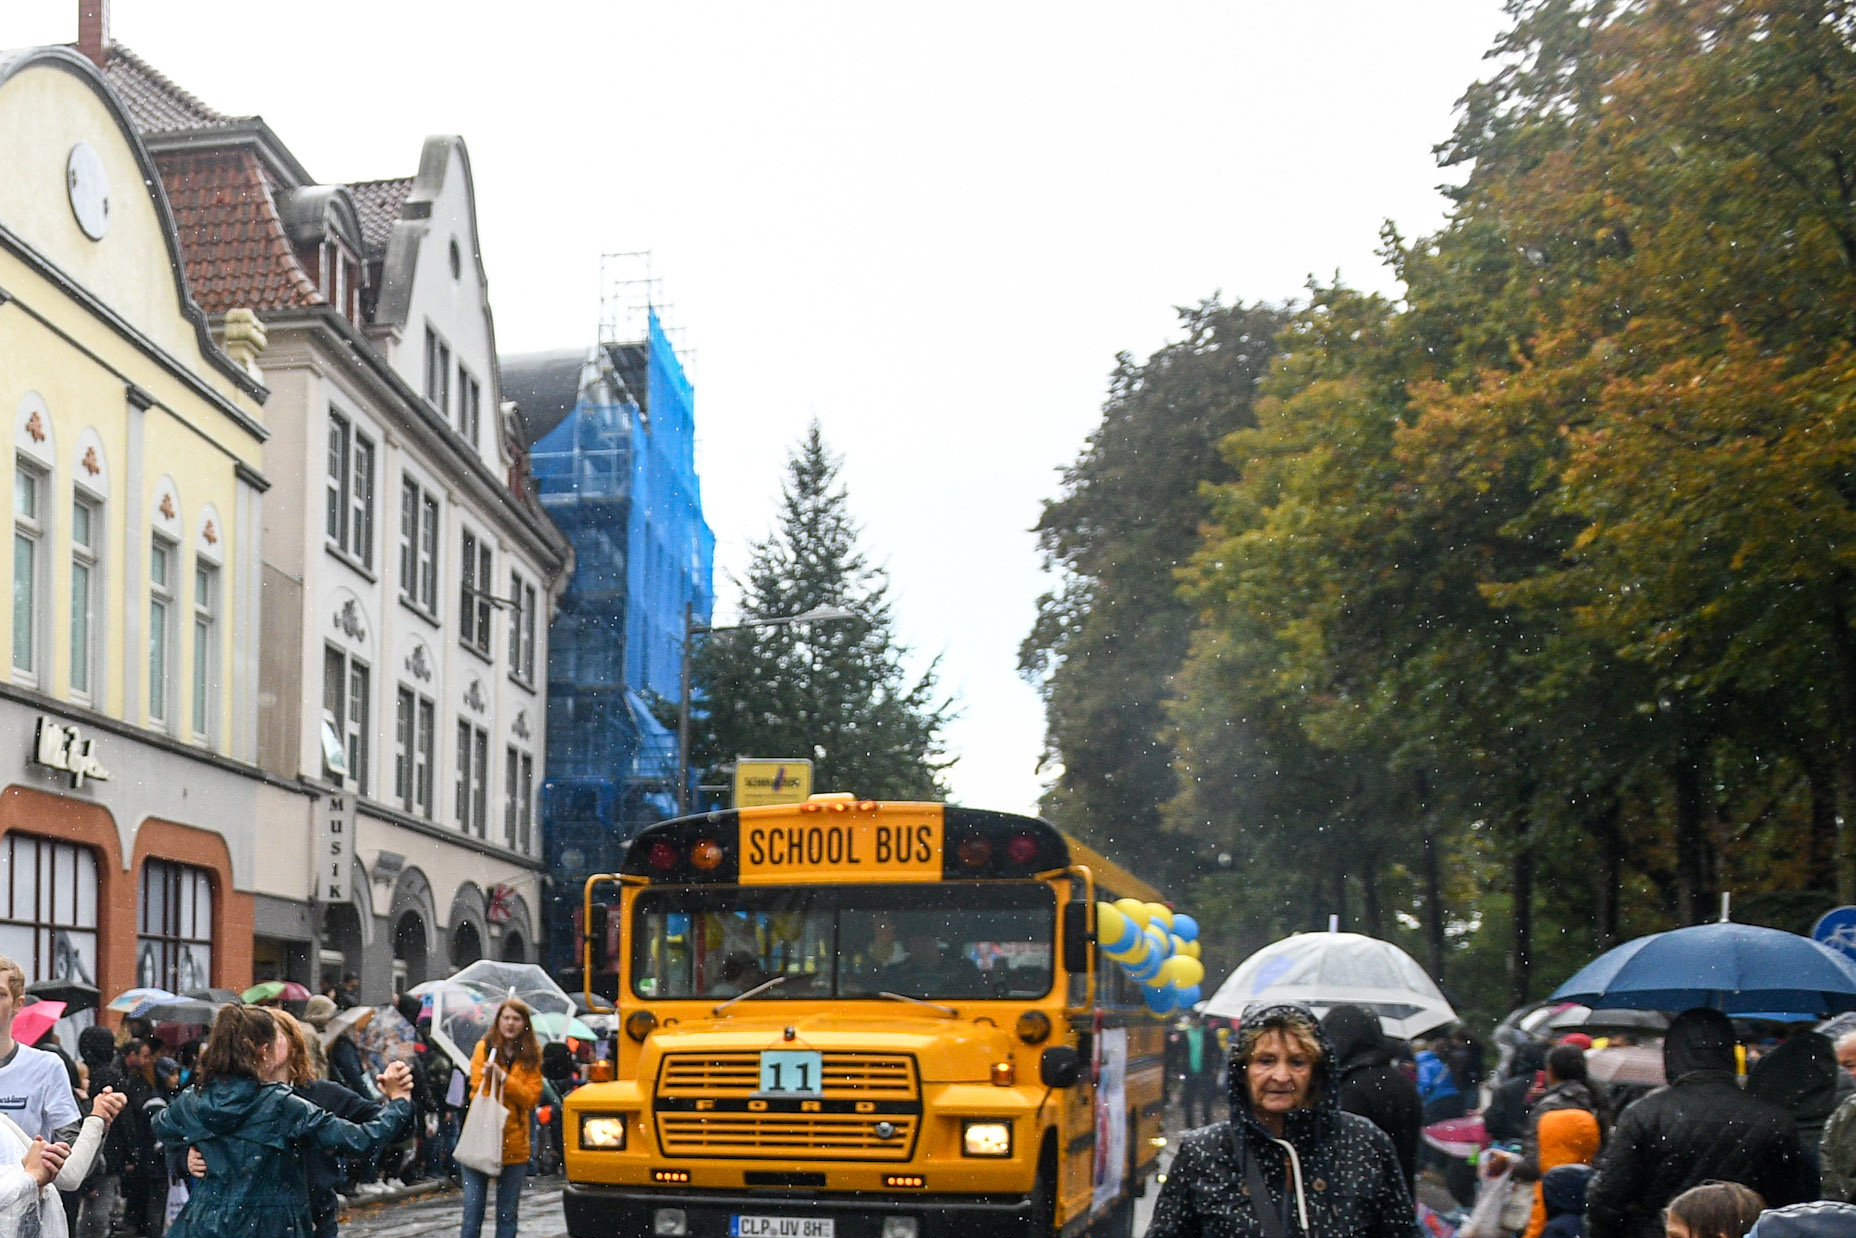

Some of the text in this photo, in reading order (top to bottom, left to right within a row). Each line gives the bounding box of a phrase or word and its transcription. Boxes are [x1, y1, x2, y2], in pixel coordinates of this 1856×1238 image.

[328, 797, 344, 899] MUSIK
[749, 825, 932, 865] SCHOOL BUS
[768, 1061, 813, 1091] 11
[695, 1099, 876, 1113] FORD
[741, 1218, 770, 1235] CLP
[780, 1219, 799, 1236] UV
